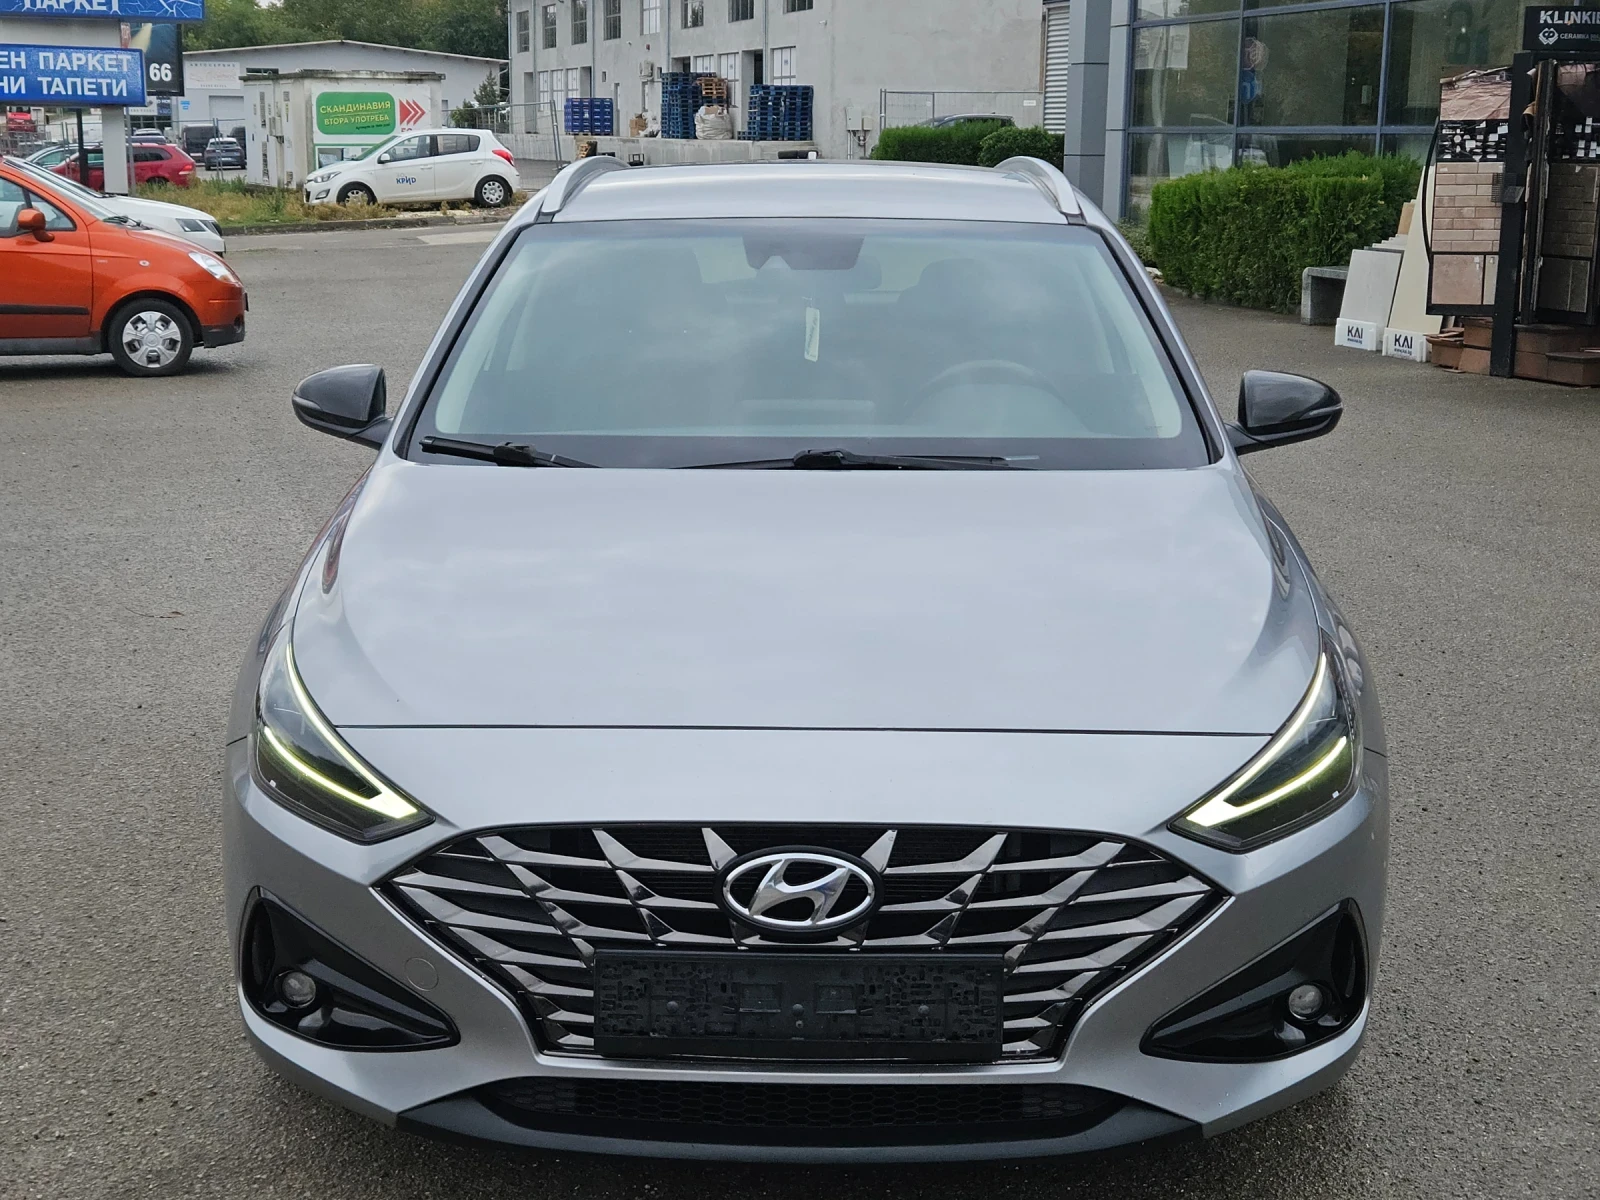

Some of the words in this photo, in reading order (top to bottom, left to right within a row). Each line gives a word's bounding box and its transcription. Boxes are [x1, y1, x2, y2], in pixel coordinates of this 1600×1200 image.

[23, 0, 120, 11] ПАРКЕТ
[39, 52, 131, 72] ПАРКЕТ
[149, 63, 172, 81] 66
[37, 77, 128, 97] ТАПЕТИ
[320, 101, 391, 113] СКАНДИНАВИЯ
[324, 118, 349, 126] ВТОРА
[351, 114, 389, 123] УПОТРЕБА
[1347, 325, 1363, 339] KAI
[1394, 333, 1413, 349] KAI
